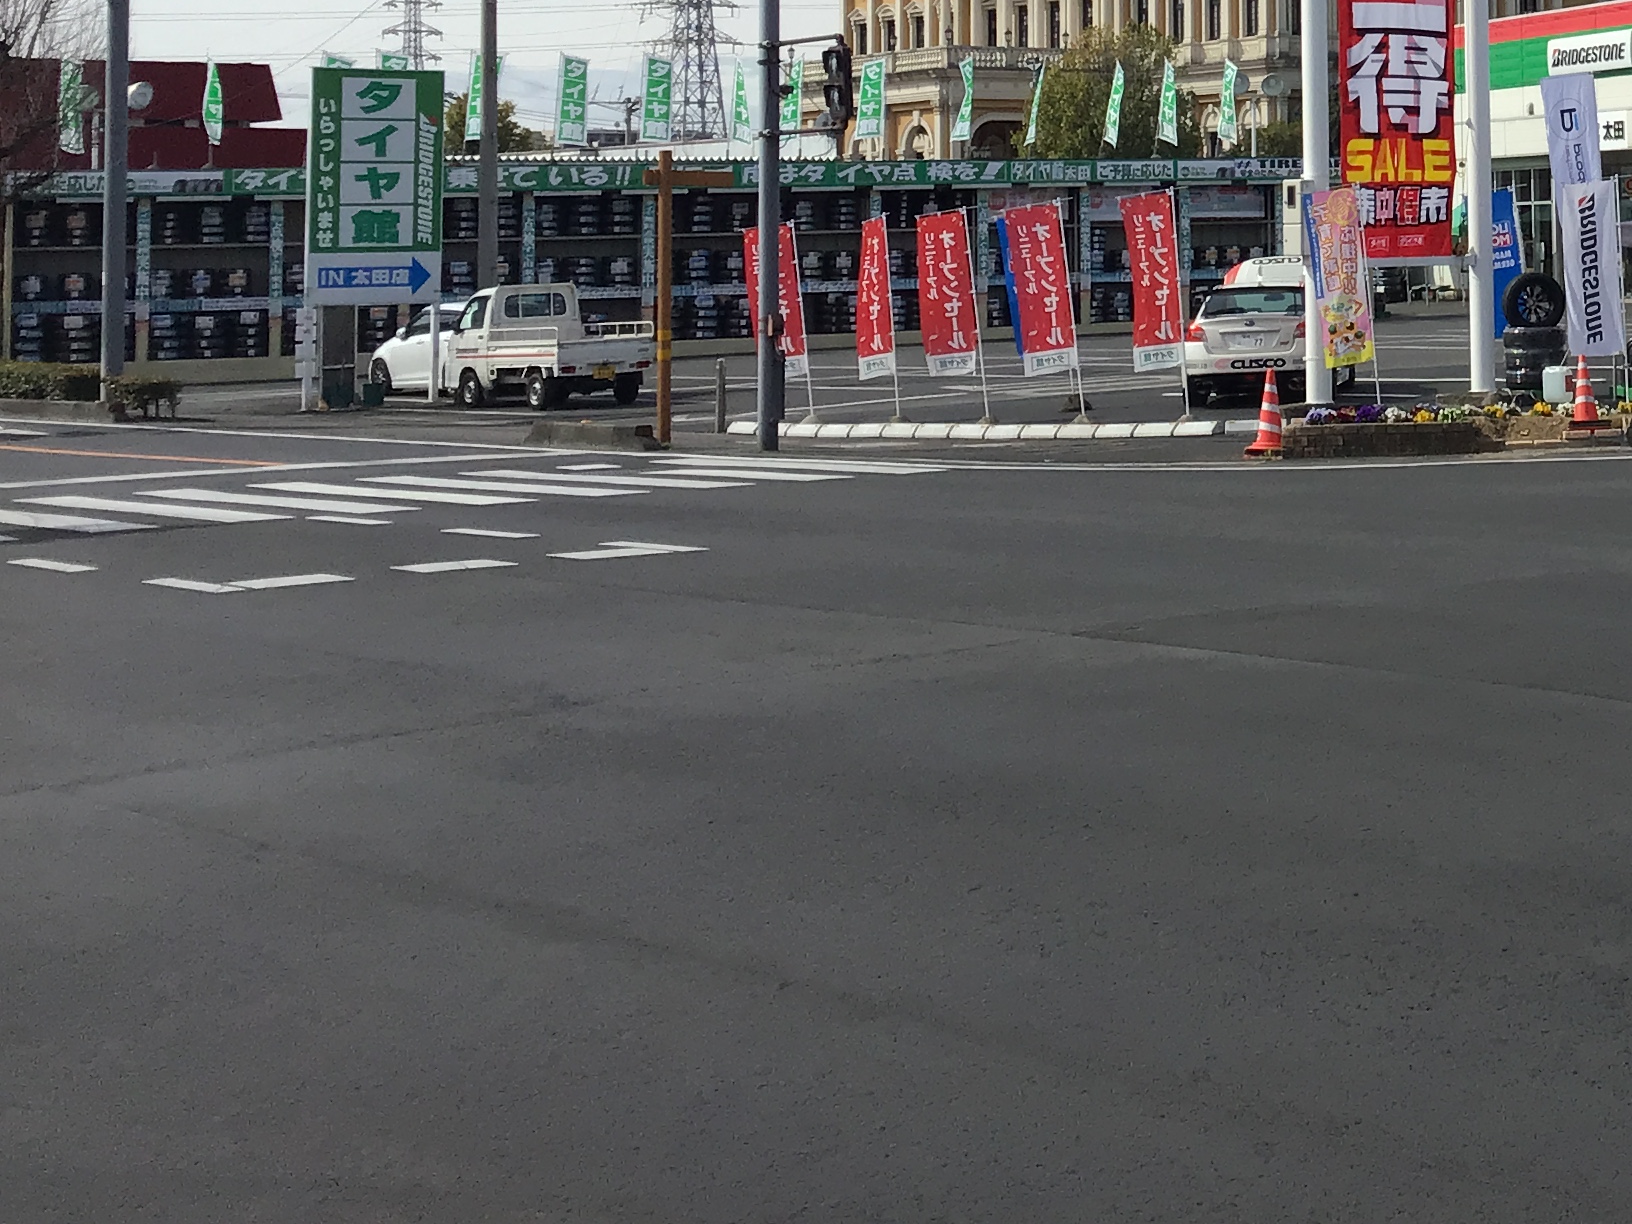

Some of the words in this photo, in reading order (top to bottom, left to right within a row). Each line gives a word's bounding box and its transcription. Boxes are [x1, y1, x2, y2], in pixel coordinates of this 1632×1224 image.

[1552, 42, 1626, 68] BRIDGESTONE
[560, 60, 584, 142] タイヤ館
[644, 61, 671, 139] タイヤ館
[1602, 120, 1625, 141] 太田
[316, 97, 336, 248] いらっしゃいませ
[351, 80, 403, 244] タイヤ館
[1257, 158, 1302, 170] TIRE
[1345, 138, 1453, 183] SALE
[417, 112, 438, 246] BRIDGESTONE
[320, 269, 344, 286] IN
[351, 269, 410, 286] 太田店
[1253, 338, 1264, 347] 77
[1230, 358, 1287, 370] CUSCO
